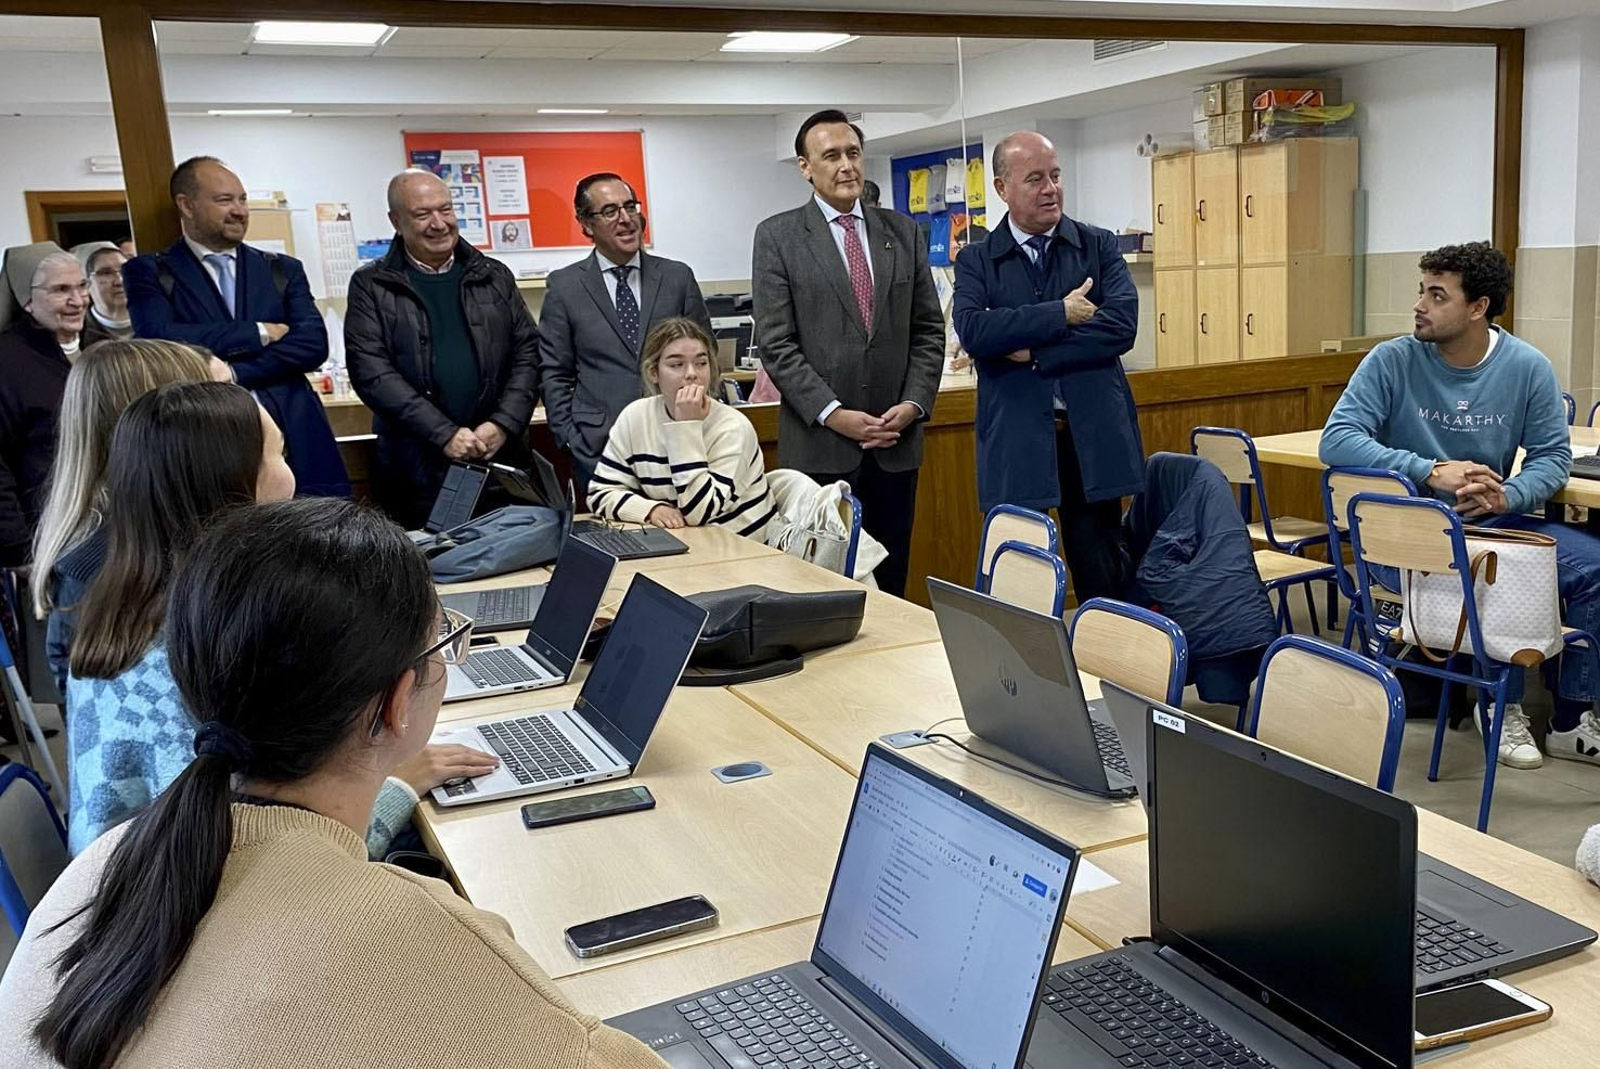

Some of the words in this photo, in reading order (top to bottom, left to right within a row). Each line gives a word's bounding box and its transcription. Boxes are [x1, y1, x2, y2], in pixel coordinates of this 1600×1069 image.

[1418, 407, 1506, 426] MAKARTHY
[1380, 601, 1403, 619] EA7
[1158, 714, 1169, 724] PC
[1170, 719, 1180, 727] 02
